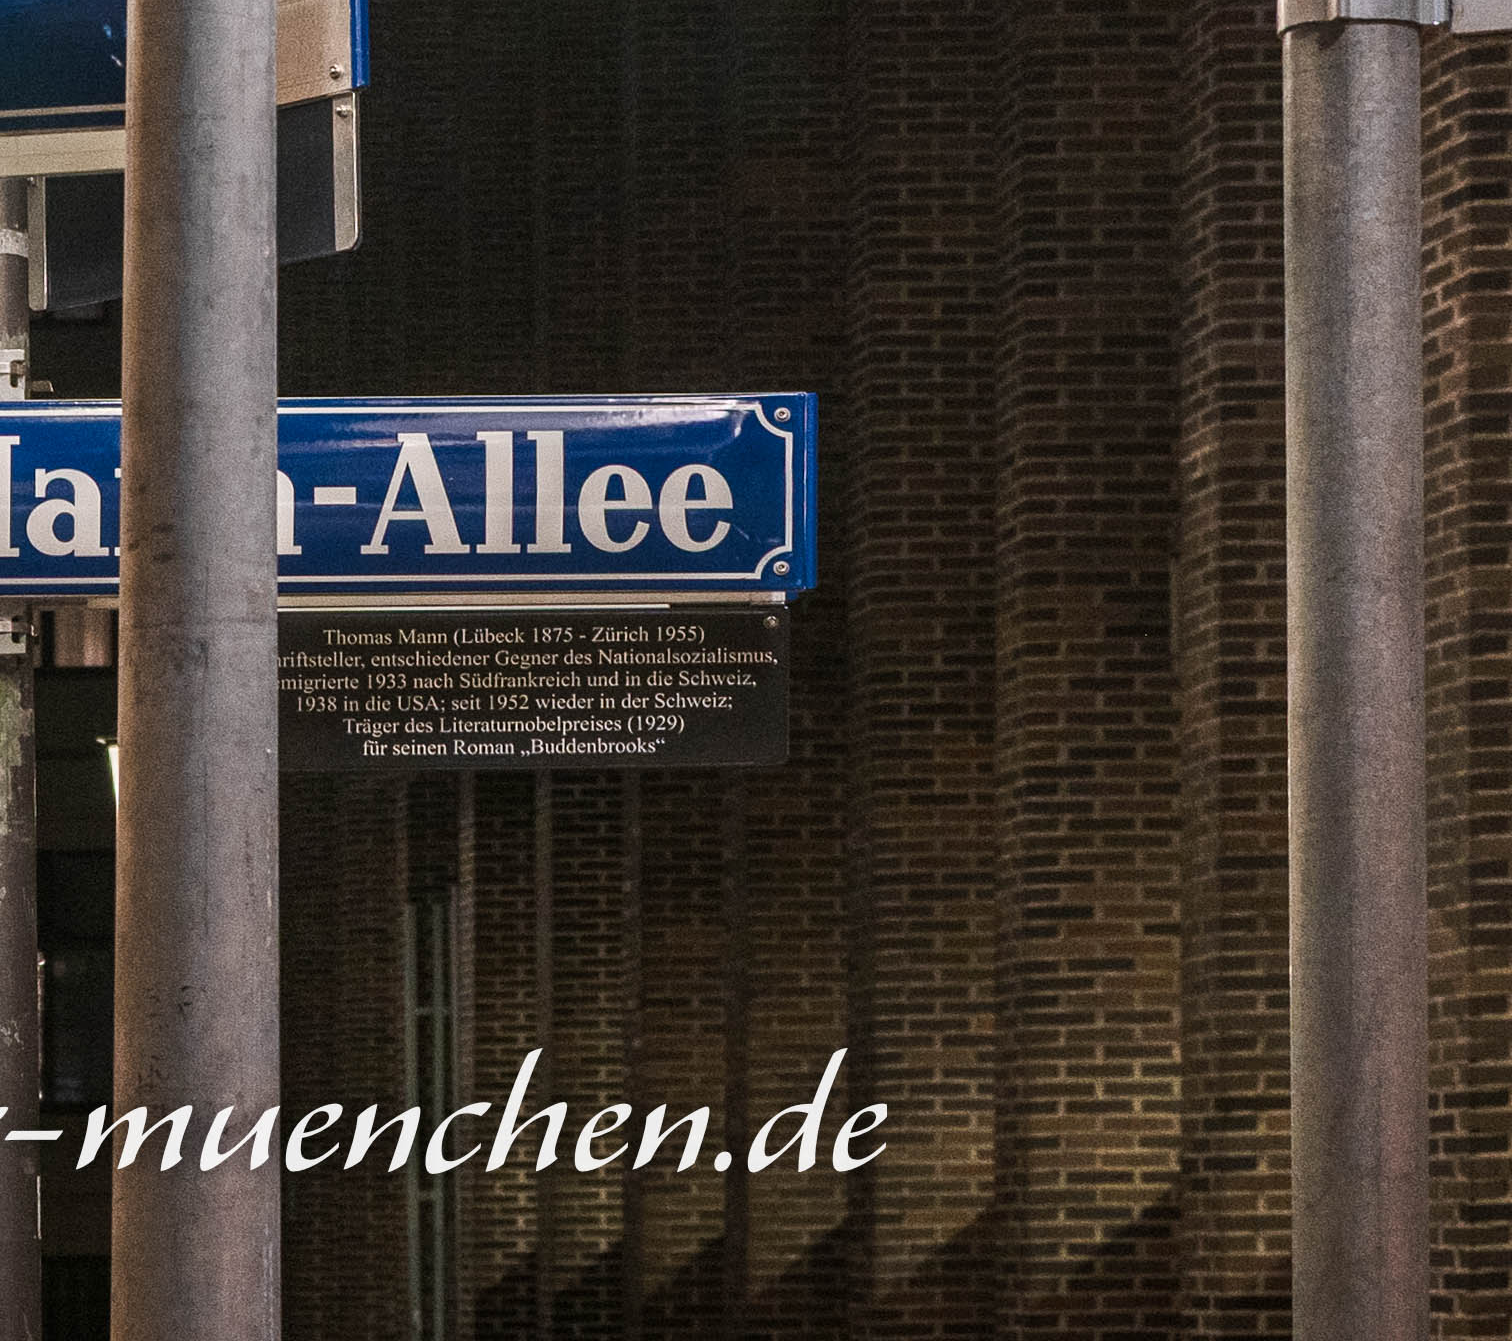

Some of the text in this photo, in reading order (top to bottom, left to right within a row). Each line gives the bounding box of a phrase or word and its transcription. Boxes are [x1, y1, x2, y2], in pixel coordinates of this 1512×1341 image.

[323, 629, 392, 645] Thomas
[399, 629, 447, 644] Mann
[453, 627, 524, 646] (Lübeck
[534, 627, 573, 643] 1875
[592, 626, 648, 642] Zürich
[658, 626, 704, 643] 1955)
[371, 650, 490, 667] entschiedener
[495, 650, 559, 669] Gegner
[564, 649, 592, 665] des
[599, 647, 778, 665] Nationalsozialismus,
[278, 670, 756, 694] migrierte 1933 nach Südfrankreich und in die Schweiz,
[298, 692, 732, 712] 1938 in die USA; seit 1952 wieder in der Schweiz;
[343, 715, 685, 738] Träger des Literaturnobelpreises (1929)
[363, 740, 388, 756] für
[392, 739, 447, 756] seinen
[453, 739, 515, 755] Roman
